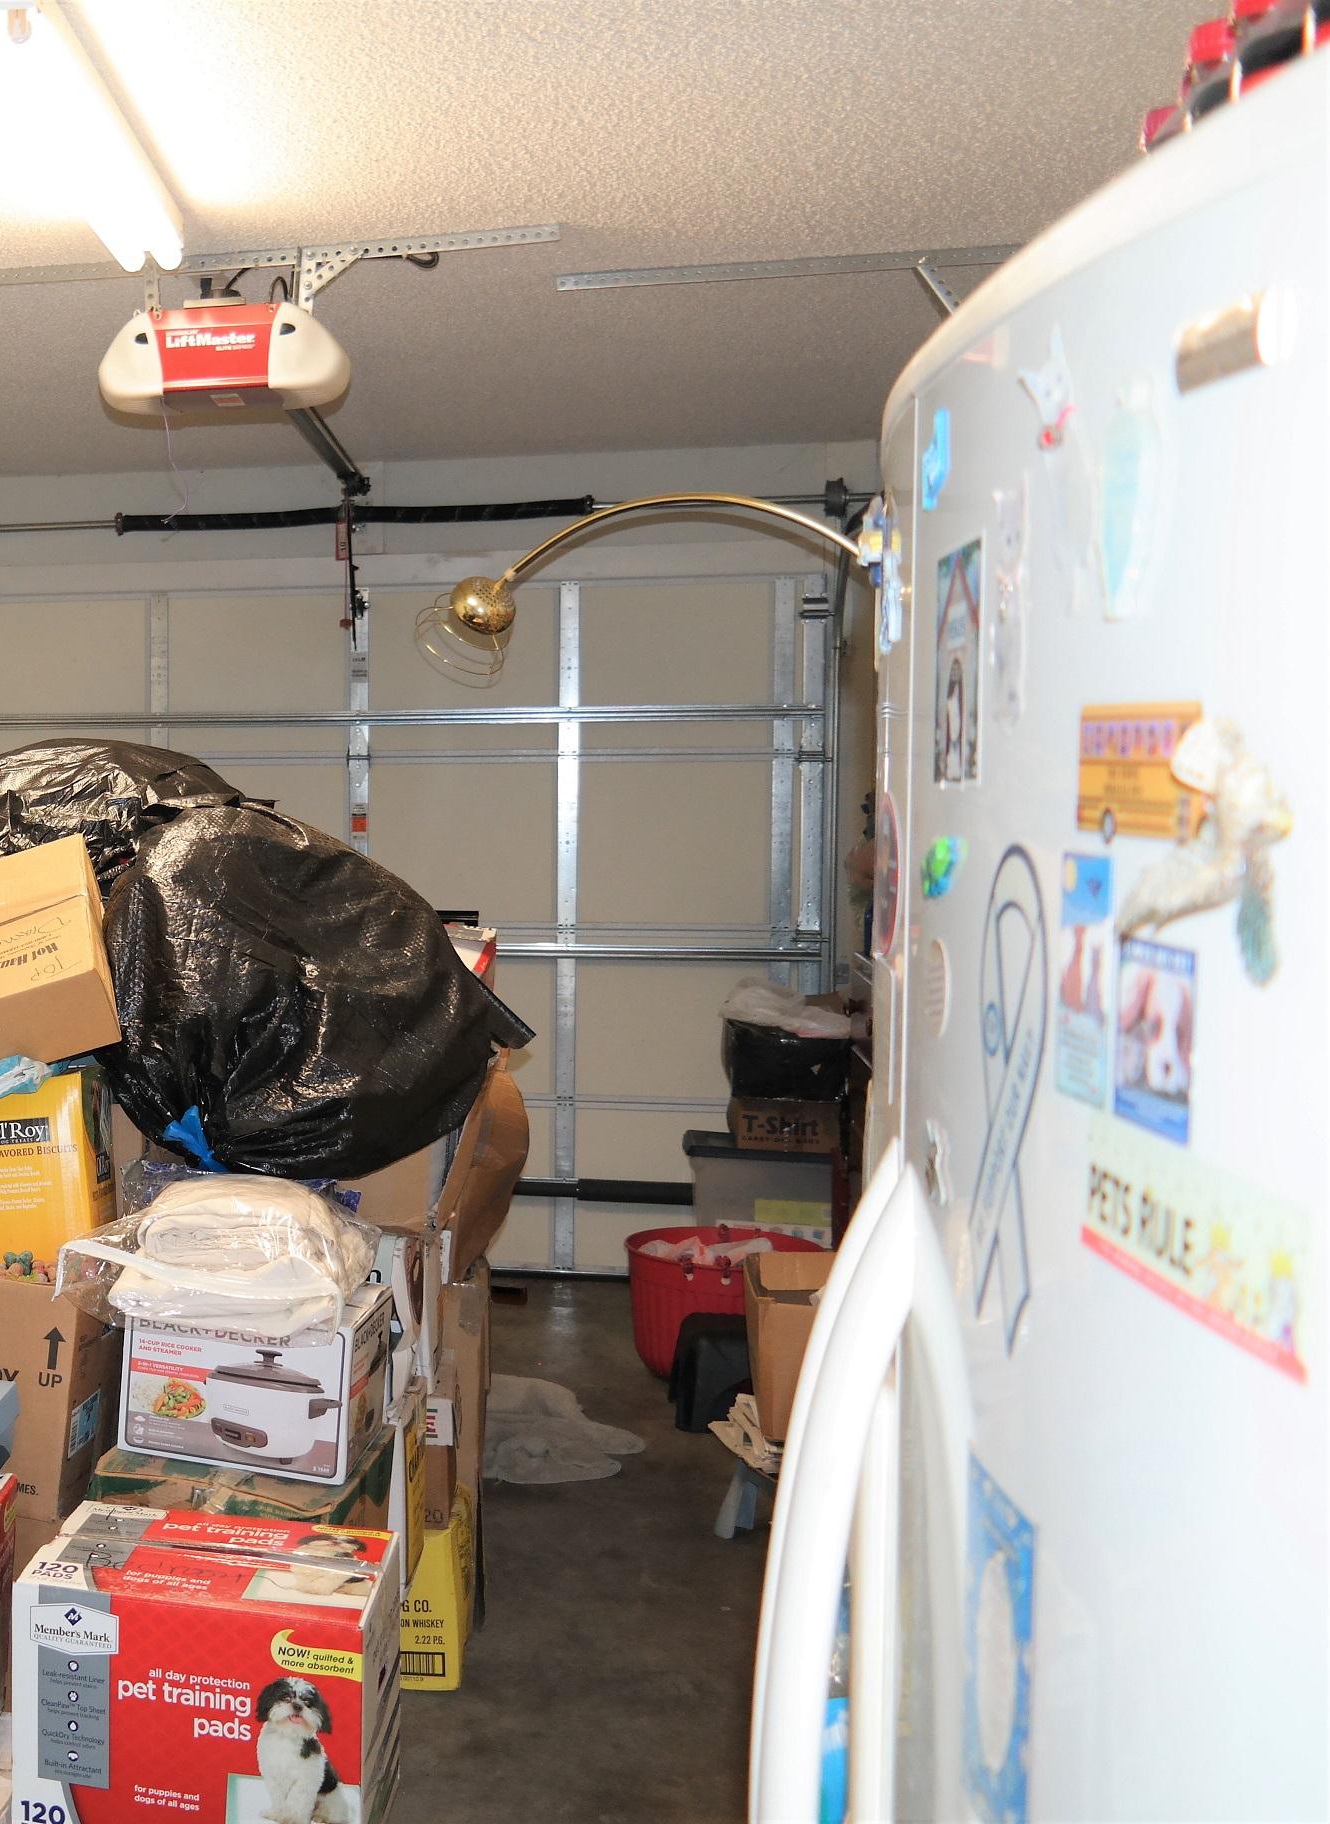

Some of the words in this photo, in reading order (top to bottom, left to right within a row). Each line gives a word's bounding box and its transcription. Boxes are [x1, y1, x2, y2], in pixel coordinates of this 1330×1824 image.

[166, 332, 255, 348] LiftMaster
[742, 1114, 820, 1137] T-Shirt
[1087, 1162, 1133, 1238] PETS
[152, 1347, 182, 1356] STEAMER
[176, 1344, 202, 1352] COOKER
[38, 1372, 62, 1387] UP
[17, 1483, 39, 1496] MES.
[163, 1523, 200, 1532] pet
[201, 1526, 289, 1540] training
[229, 1536, 285, 1547] pads
[31, 1569, 73, 1580] PADS
[39, 1562, 79, 1574] 120
[122, 1575, 151, 1585] dogs
[182, 1583, 208, 1591] ages
[144, 1573, 188, 1583] puppies
[189, 1577, 211, 1585] and
[414, 1600, 432, 1613] CO.
[412, 1618, 445, 1629] WHISKEY
[34, 1623, 81, 1638] Member's
[83, 1631, 110, 1643] Mark
[415, 1635, 432, 1644] 2.22
[33, 1634, 64, 1643] QUALITY
[65, 1637, 112, 1649] GUARANTEED
[277, 1646, 310, 1659] NOW!
[312, 1653, 345, 1664] quilted
[347, 1656, 354, 1664] &
[281, 1658, 304, 1668] more
[307, 1660, 355, 1674] absorbent
[88, 1675, 105, 1684] Liner
[149, 1667, 162, 1678] all
[165, 1670, 186, 1683] day
[189, 1673, 250, 1690] protection
[118, 1679, 156, 1700] pet
[162, 1682, 251, 1717] training
[77, 1704, 88, 1713] Top
[89, 1705, 106, 1715] Sheet
[193, 1716, 251, 1740] pads
[71, 1733, 105, 1746] Technology
[68, 1761, 102, 1774] Attractant
[134, 1784, 146, 1793] for
[148, 1787, 181, 1799] puppies
[183, 1792, 200, 1801] and
[134, 1794, 155, 1806] dogs
[157, 1797, 166, 1806] of
[168, 1799, 178, 1808] all
[179, 1802, 200, 1811] ages
[20, 1800, 66, 1824] 120
